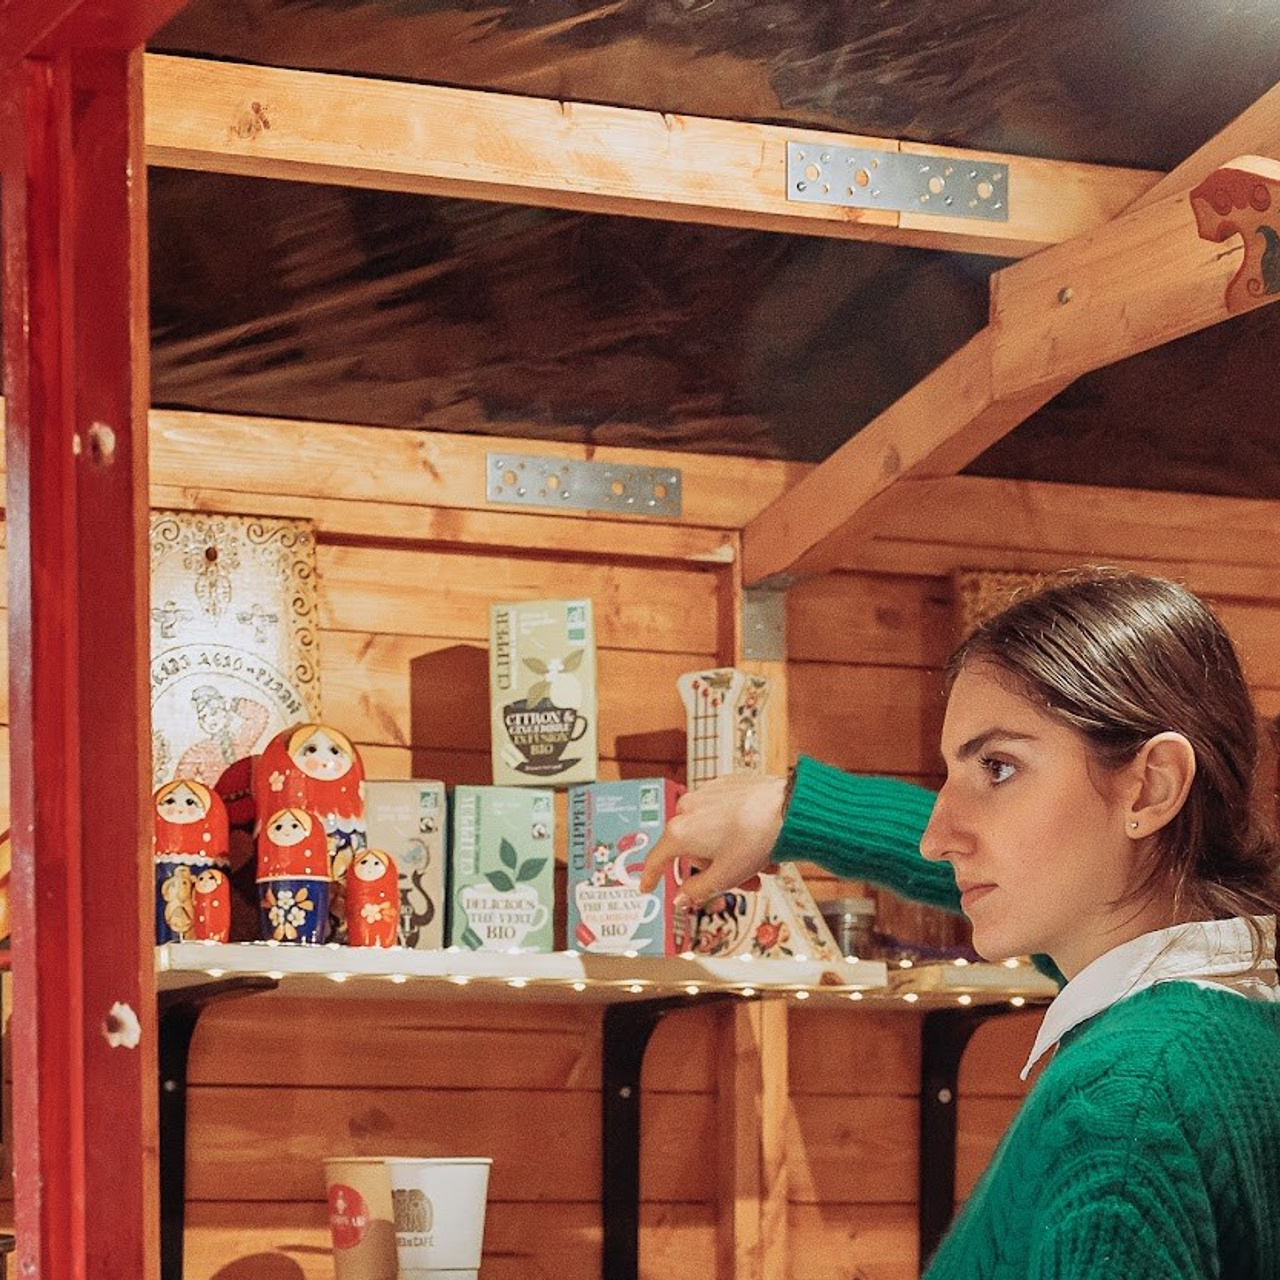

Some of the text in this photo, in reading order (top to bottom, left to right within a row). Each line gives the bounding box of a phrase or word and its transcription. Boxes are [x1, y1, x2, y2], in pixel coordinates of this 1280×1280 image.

[496, 612, 510, 690] CLIPPER
[506, 711, 560, 725] CITRON
[530, 744, 553, 756] BIO
[573, 791, 585, 870] CLIPPER
[499, 912, 533, 924] VERT
[487, 925, 516, 940] BIO
[601, 924, 628, 937] BIO
